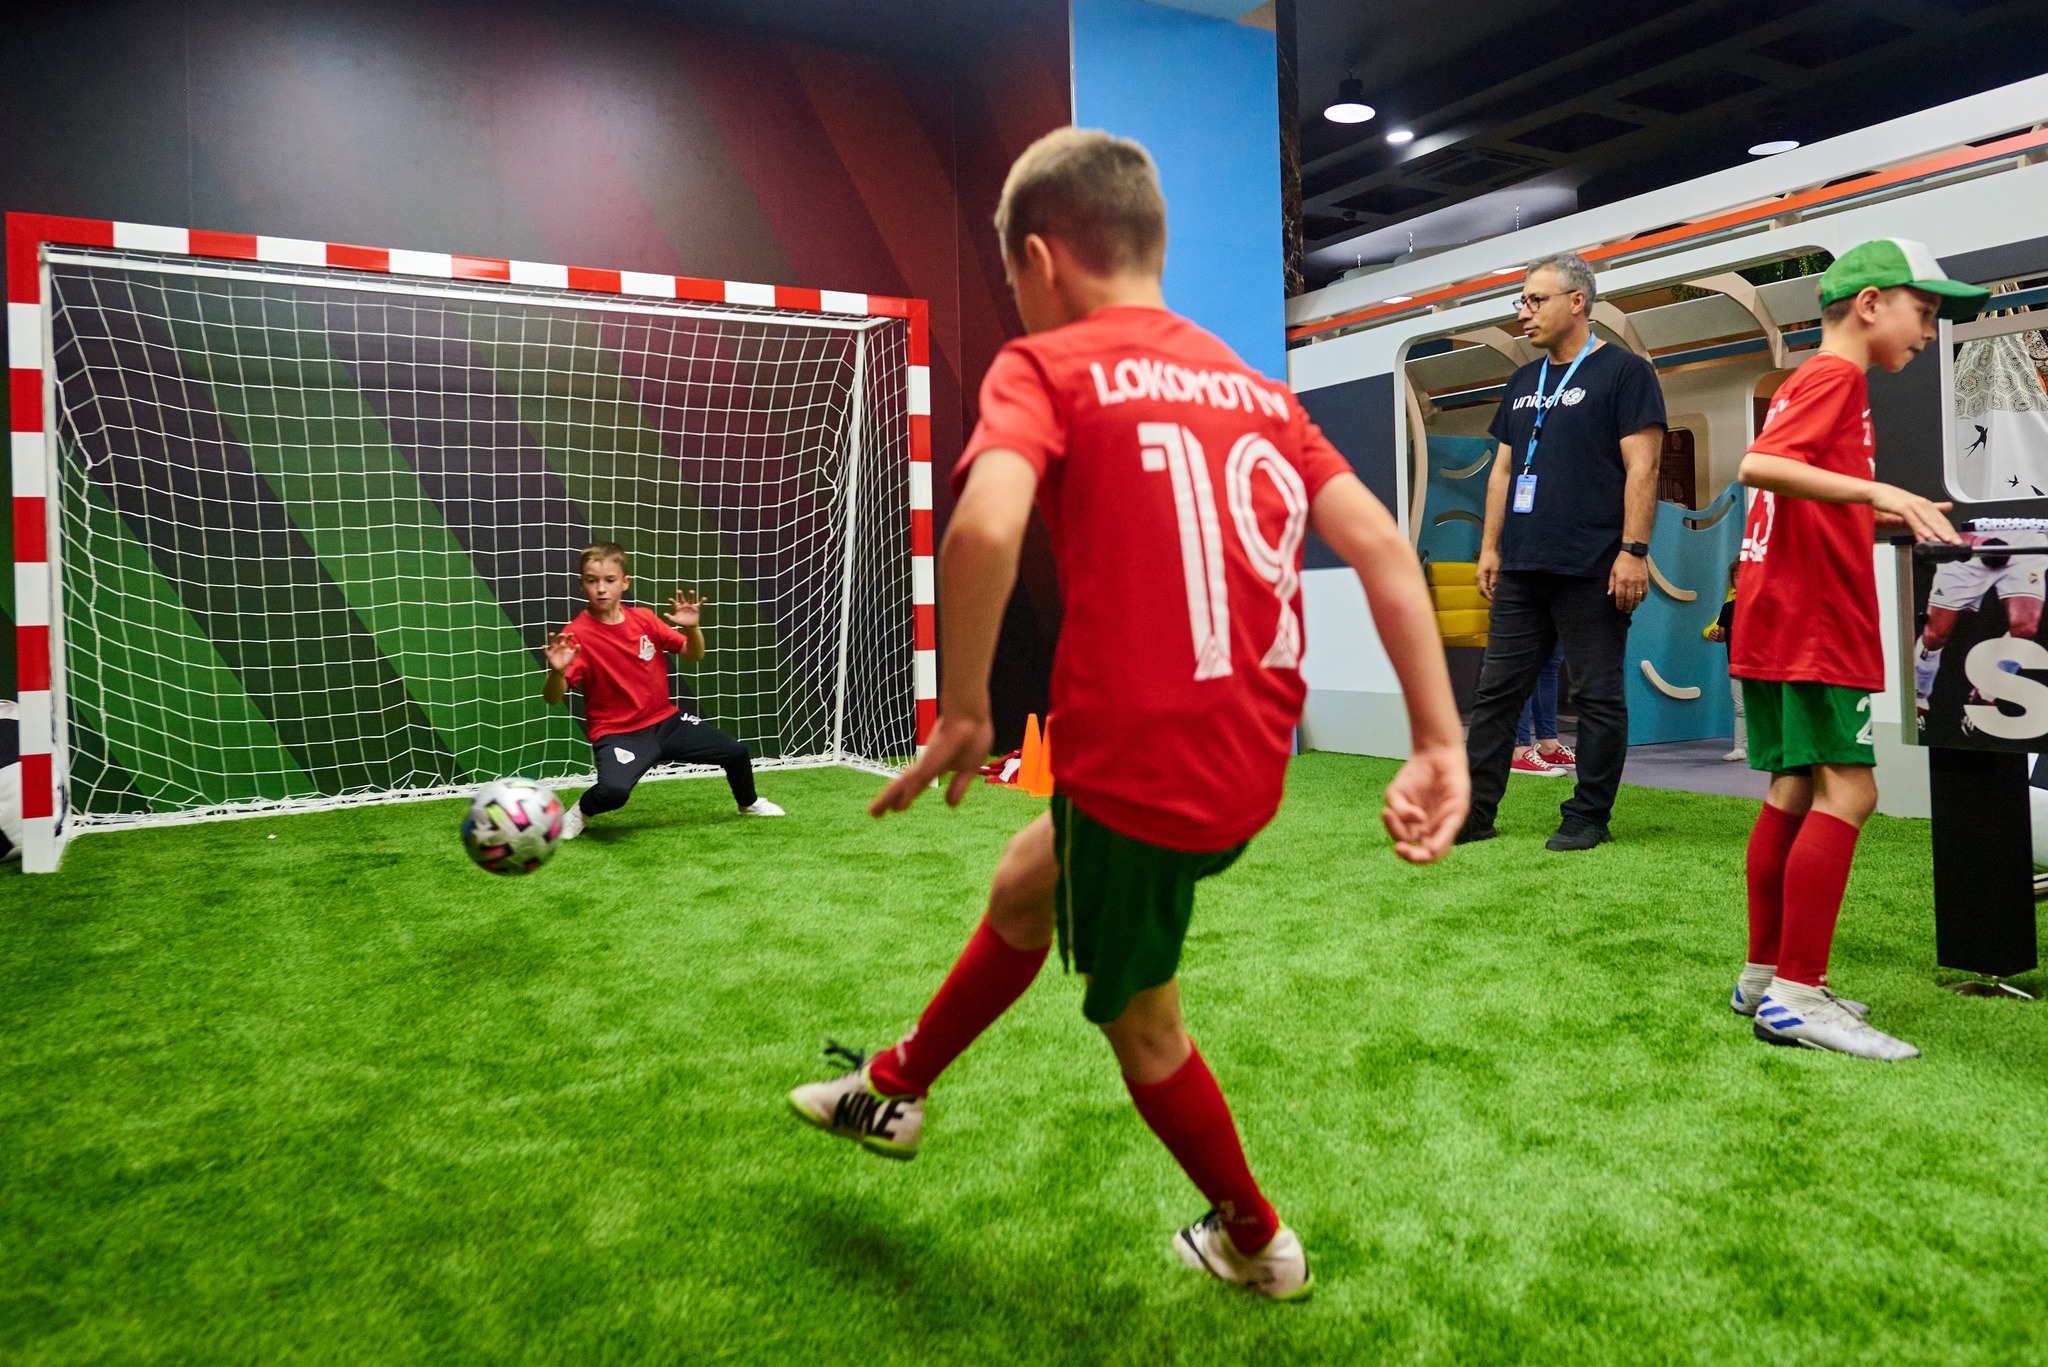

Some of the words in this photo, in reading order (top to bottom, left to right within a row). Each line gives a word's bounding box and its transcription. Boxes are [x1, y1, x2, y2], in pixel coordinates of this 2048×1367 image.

[1512, 389, 1566, 411] unicef
[1137, 422, 1308, 682] 19
[833, 1091, 918, 1140] NIKE
